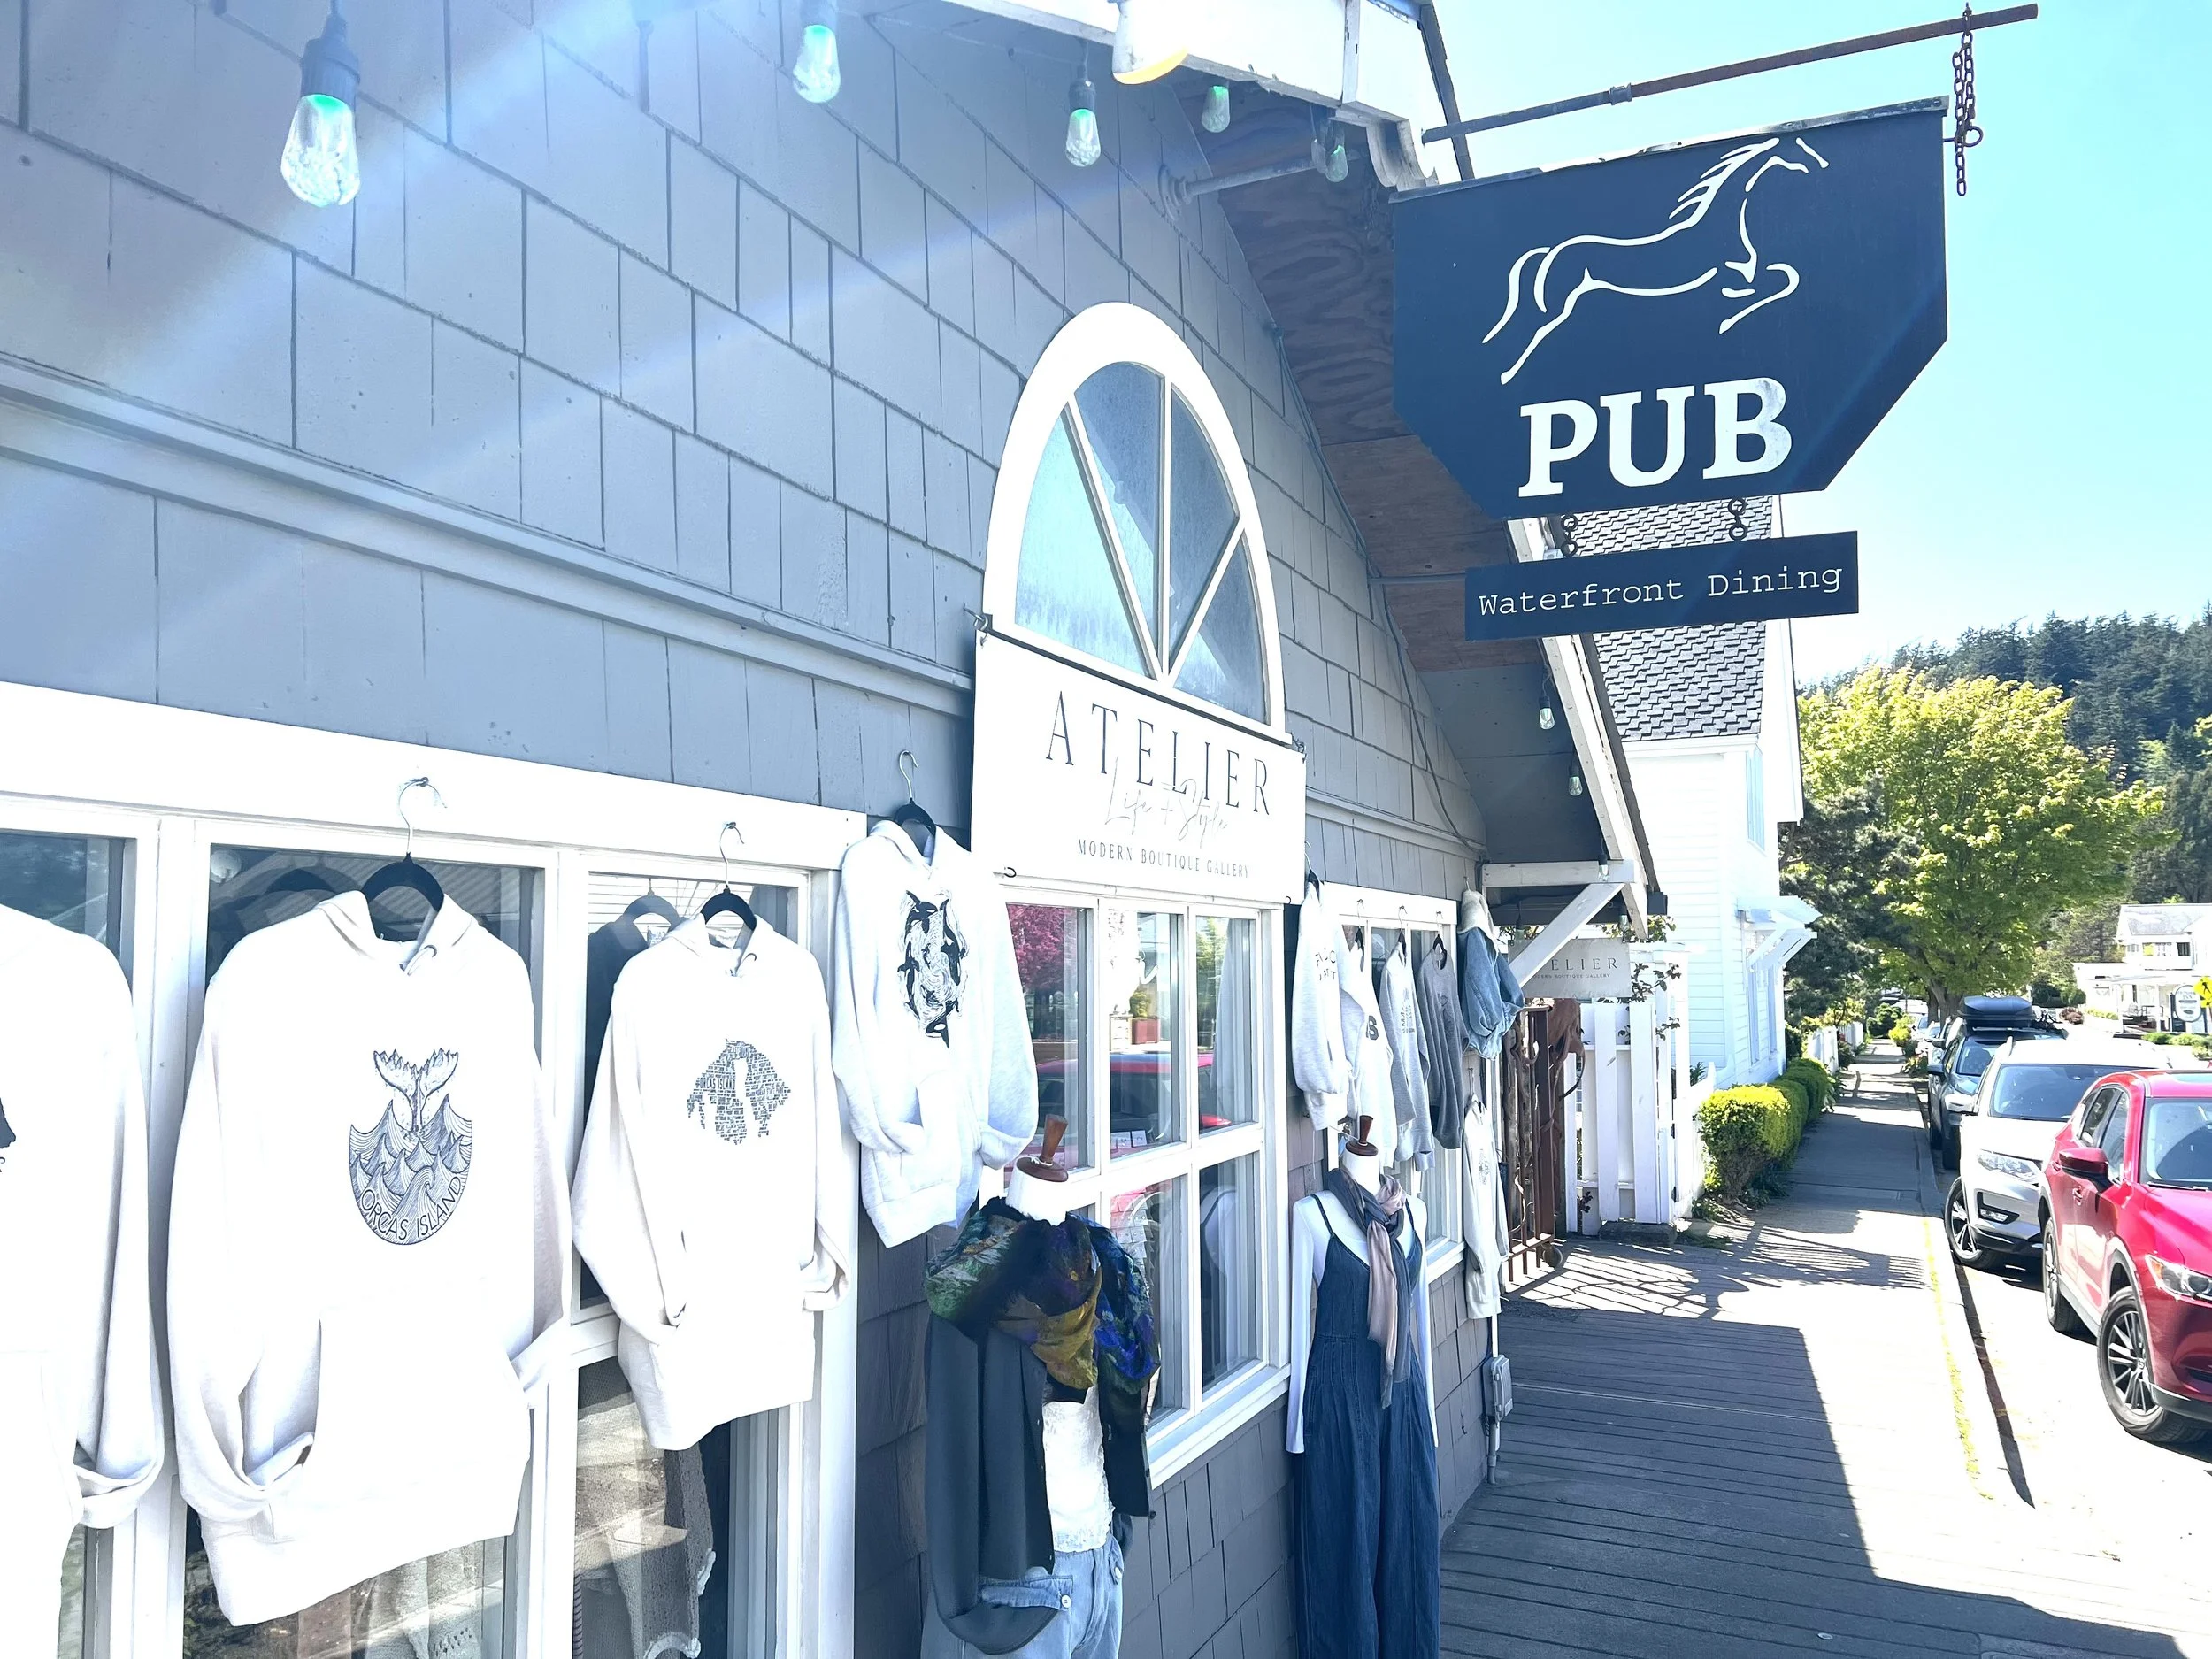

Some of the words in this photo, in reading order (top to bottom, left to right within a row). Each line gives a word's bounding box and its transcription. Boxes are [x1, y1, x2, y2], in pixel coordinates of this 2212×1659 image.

[1517, 376, 1793, 498] PUB
[1478, 577, 1683, 616] Waterfront
[1707, 566, 1844, 598] Dining
[1045, 690, 1270, 816] ATELIER
[1078, 839, 1133, 862] MODERN
[1141, 849, 1201, 872] BOUTIQUE
[1206, 859, 1249, 879] GALLERY
[1550, 957, 1618, 971] ELIER
[358, 1188, 409, 1240] ORCAS
[416, 1176, 463, 1238] ISLAND
